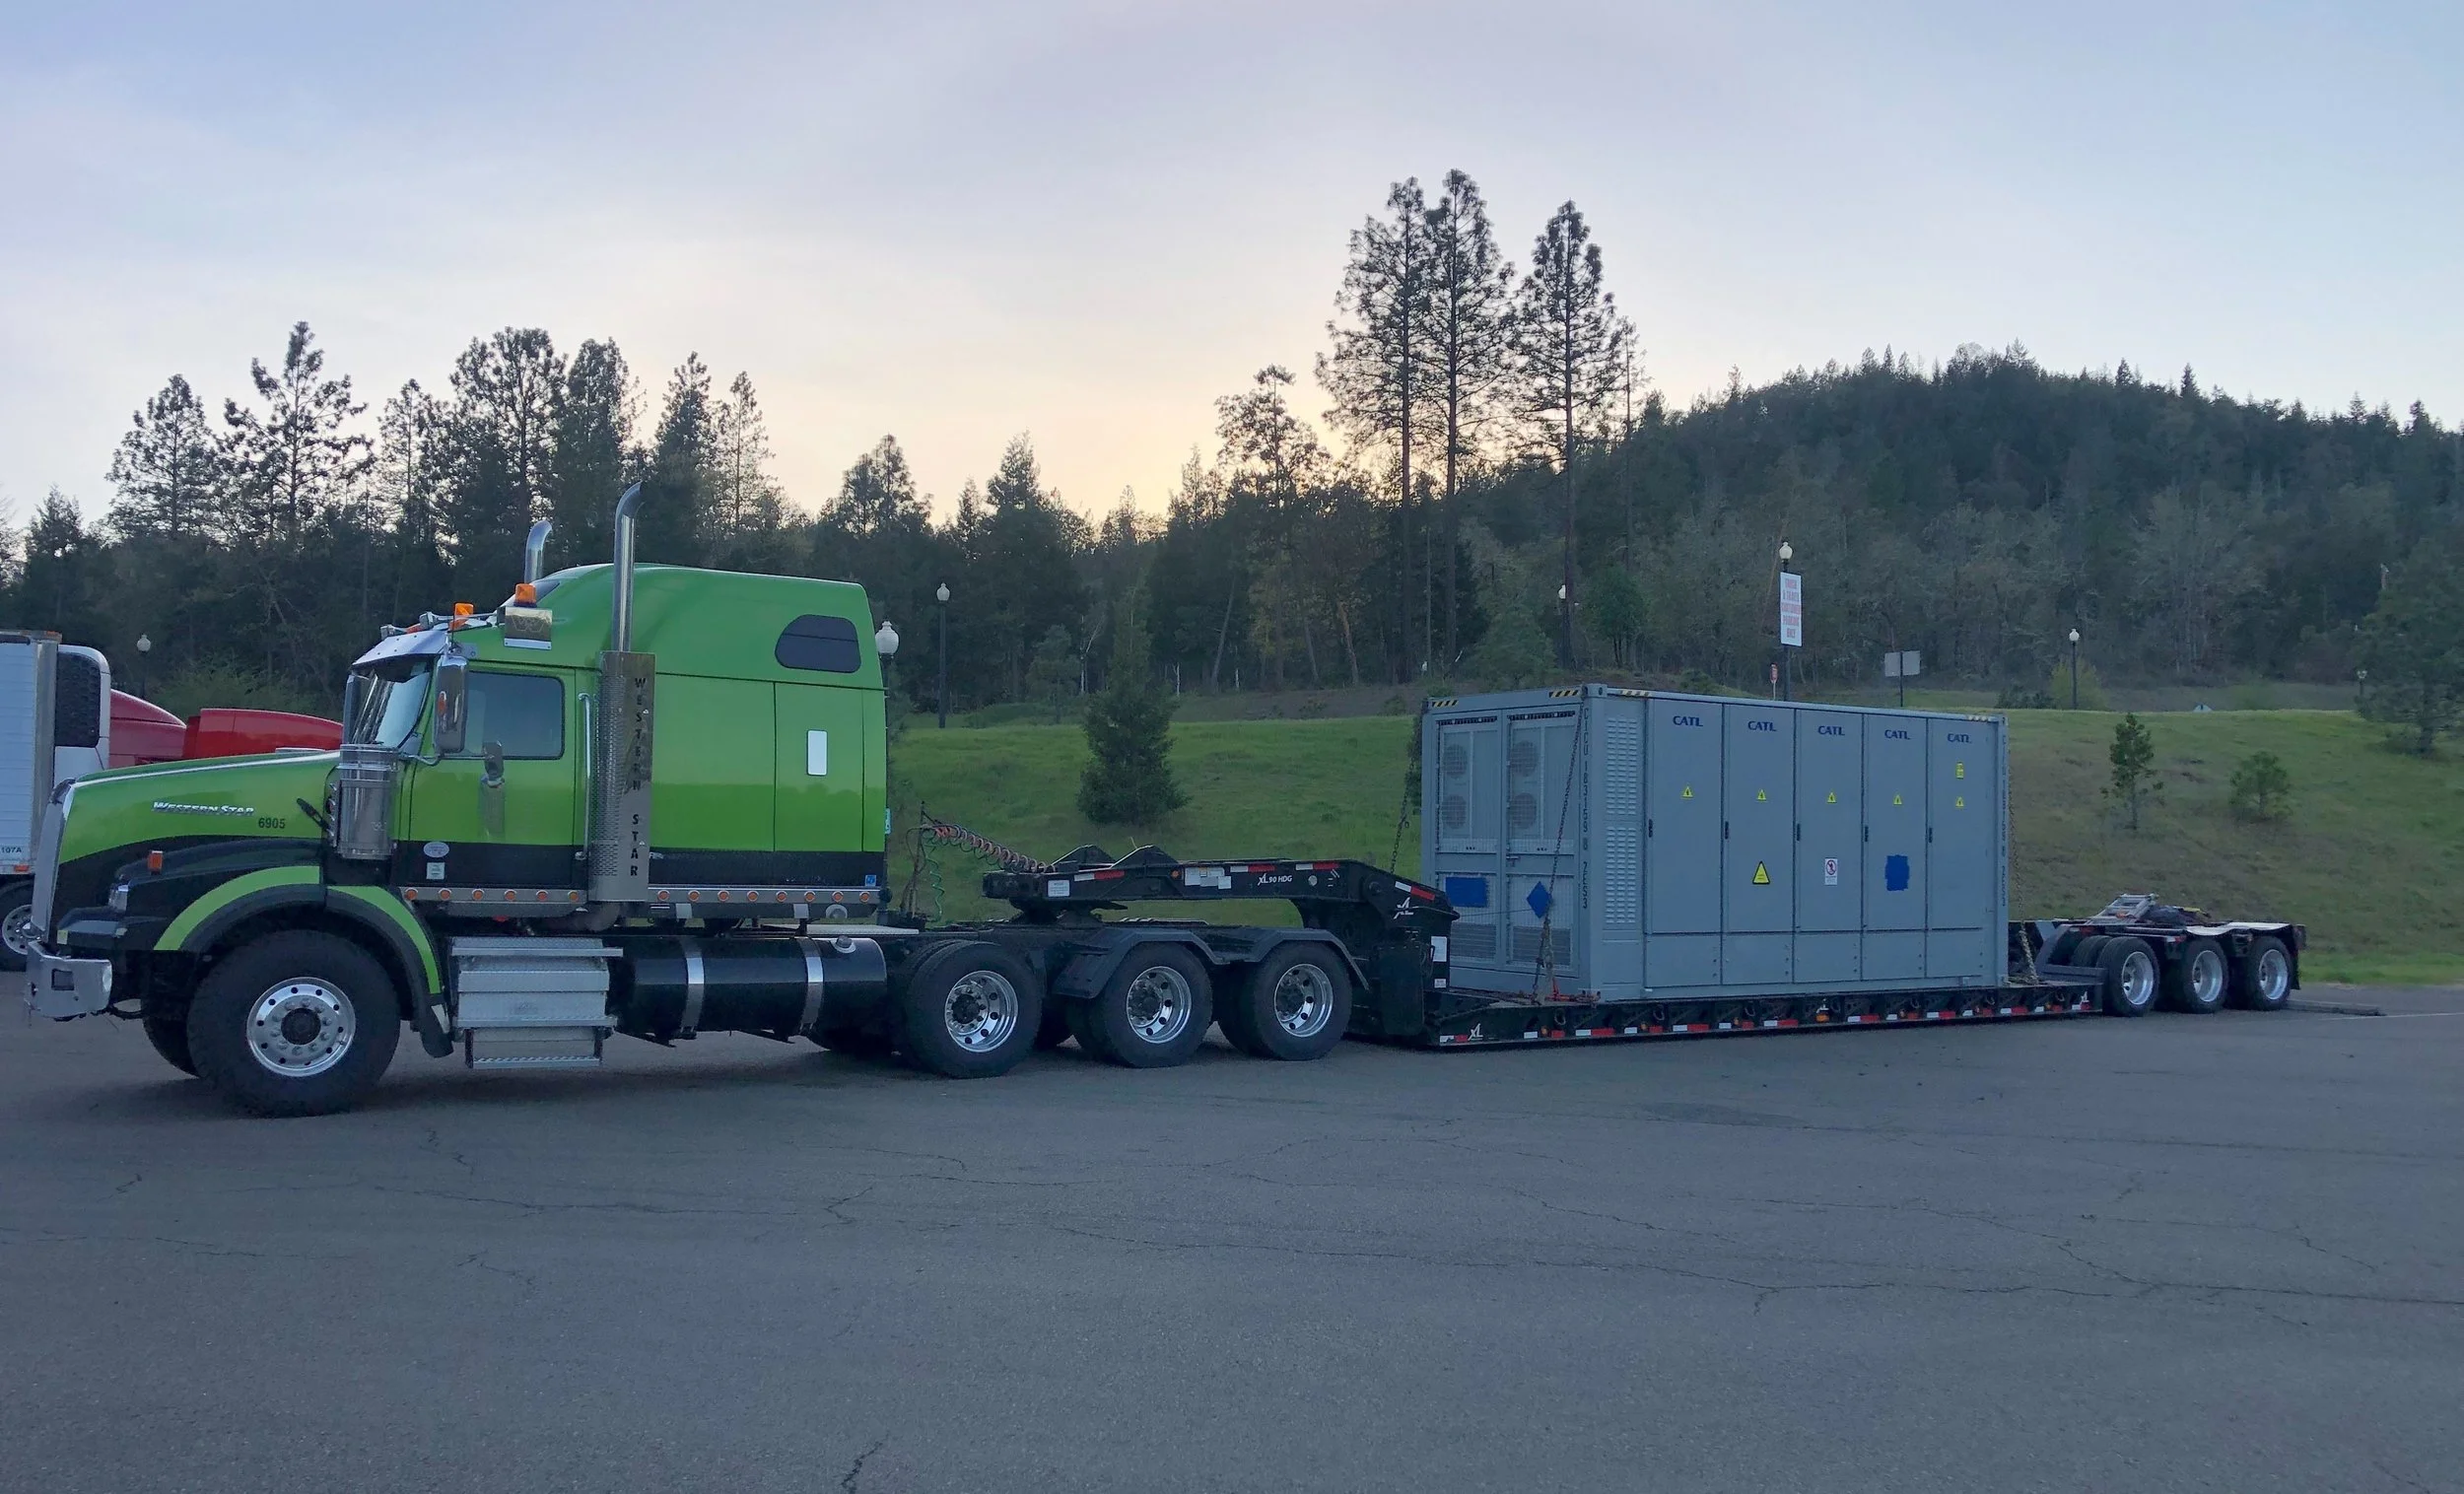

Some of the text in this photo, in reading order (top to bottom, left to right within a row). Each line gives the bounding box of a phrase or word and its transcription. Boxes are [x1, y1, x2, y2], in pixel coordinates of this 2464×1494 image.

[1673, 715, 1704, 727] CATL
[1747, 720, 1777, 732] CATL
[1817, 725, 1845, 736] CATL
[1883, 728, 1911, 740] CATL
[1947, 733, 1972, 744] CATL
[153, 801, 254, 817] WESTERN STAR
[258, 817, 287, 829] 6905
[631, 813, 640, 876] STAR
